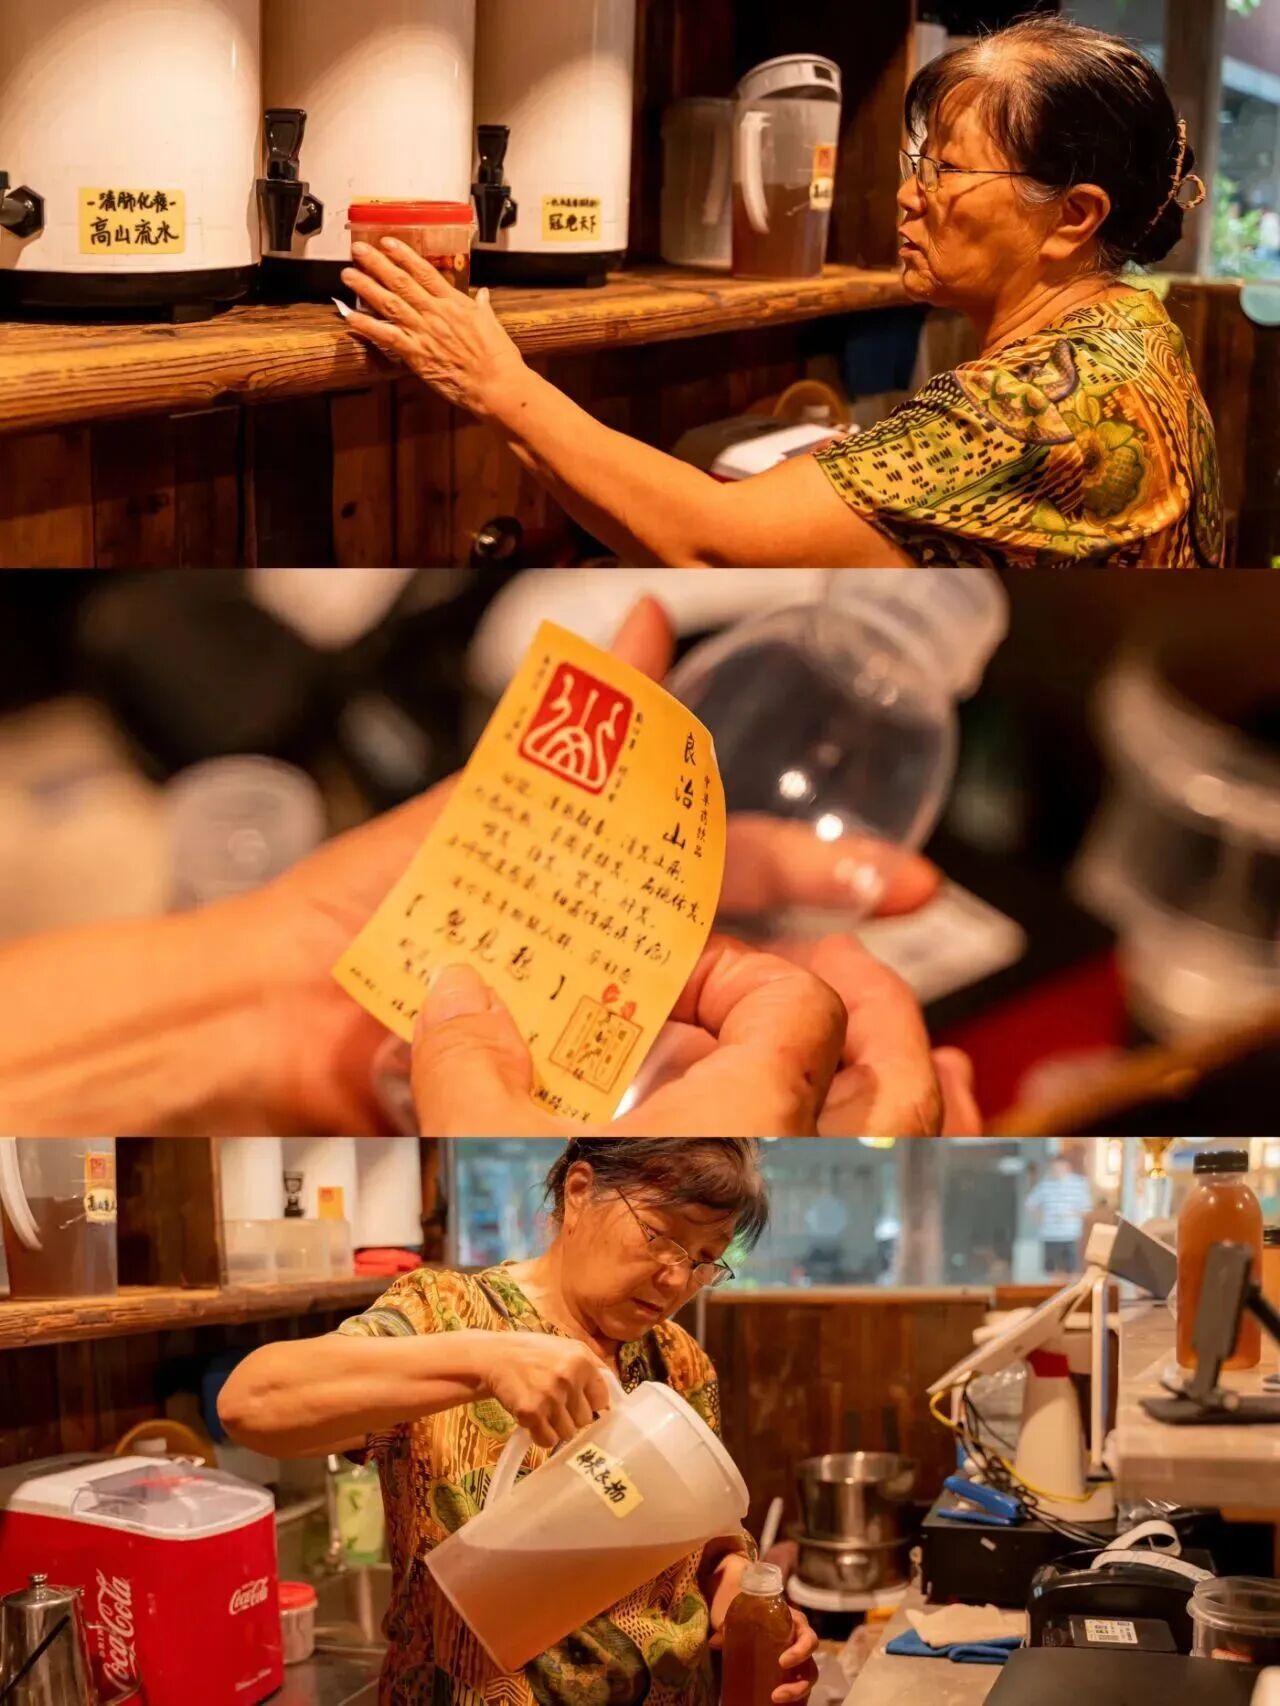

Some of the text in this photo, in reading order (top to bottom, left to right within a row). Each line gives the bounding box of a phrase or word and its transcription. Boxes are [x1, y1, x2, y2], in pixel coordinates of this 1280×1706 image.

[89, 216, 180, 247] 高山流水
[663, 731, 696, 850] 良治山
